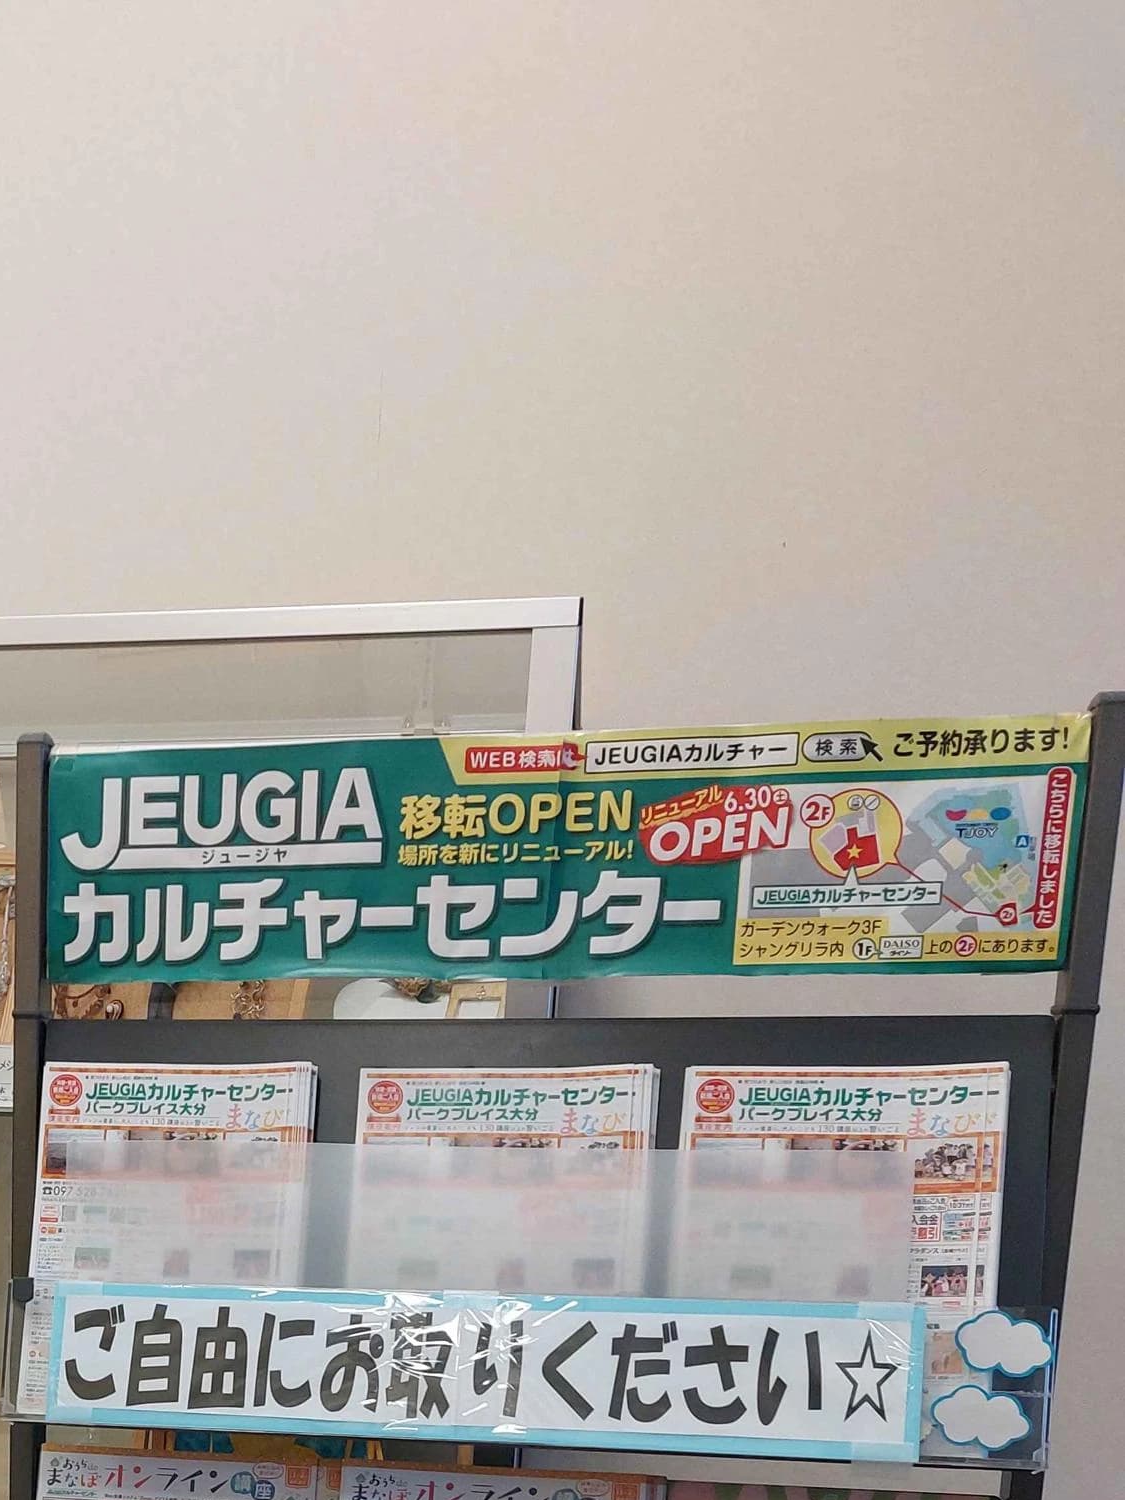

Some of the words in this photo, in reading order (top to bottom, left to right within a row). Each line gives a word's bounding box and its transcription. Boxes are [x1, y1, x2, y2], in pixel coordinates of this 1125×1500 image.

[594, 740, 789, 765] JEUGIAカルチャー
[815, 738, 860, 757] 検索
[398, 788, 633, 841] 移転OPEN
[641, 784, 724, 825] リニューアル
[803, 799, 833, 823] 2F
[60, 766, 383, 871] JEUGIA
[649, 807, 791, 862] OPEN
[1035, 772, 1069, 926] こちらに移転しました
[757, 886, 938, 905] JEUGIAカルチャーセンター
[63, 868, 722, 964] カルチャーセンター
[741, 919, 882, 938] ガーデンウォーク3F
[740, 941, 844, 959] シャングリラ内
[85, 1082, 288, 1102] JEUGIAカルチャーセンター
[407, 1086, 629, 1106] JEUGIAカルチャーセンター
[739, 1085, 986, 1107] JEUGIAカルチャーセンター
[64, 1302, 824, 1424] ご自由にお取りください
